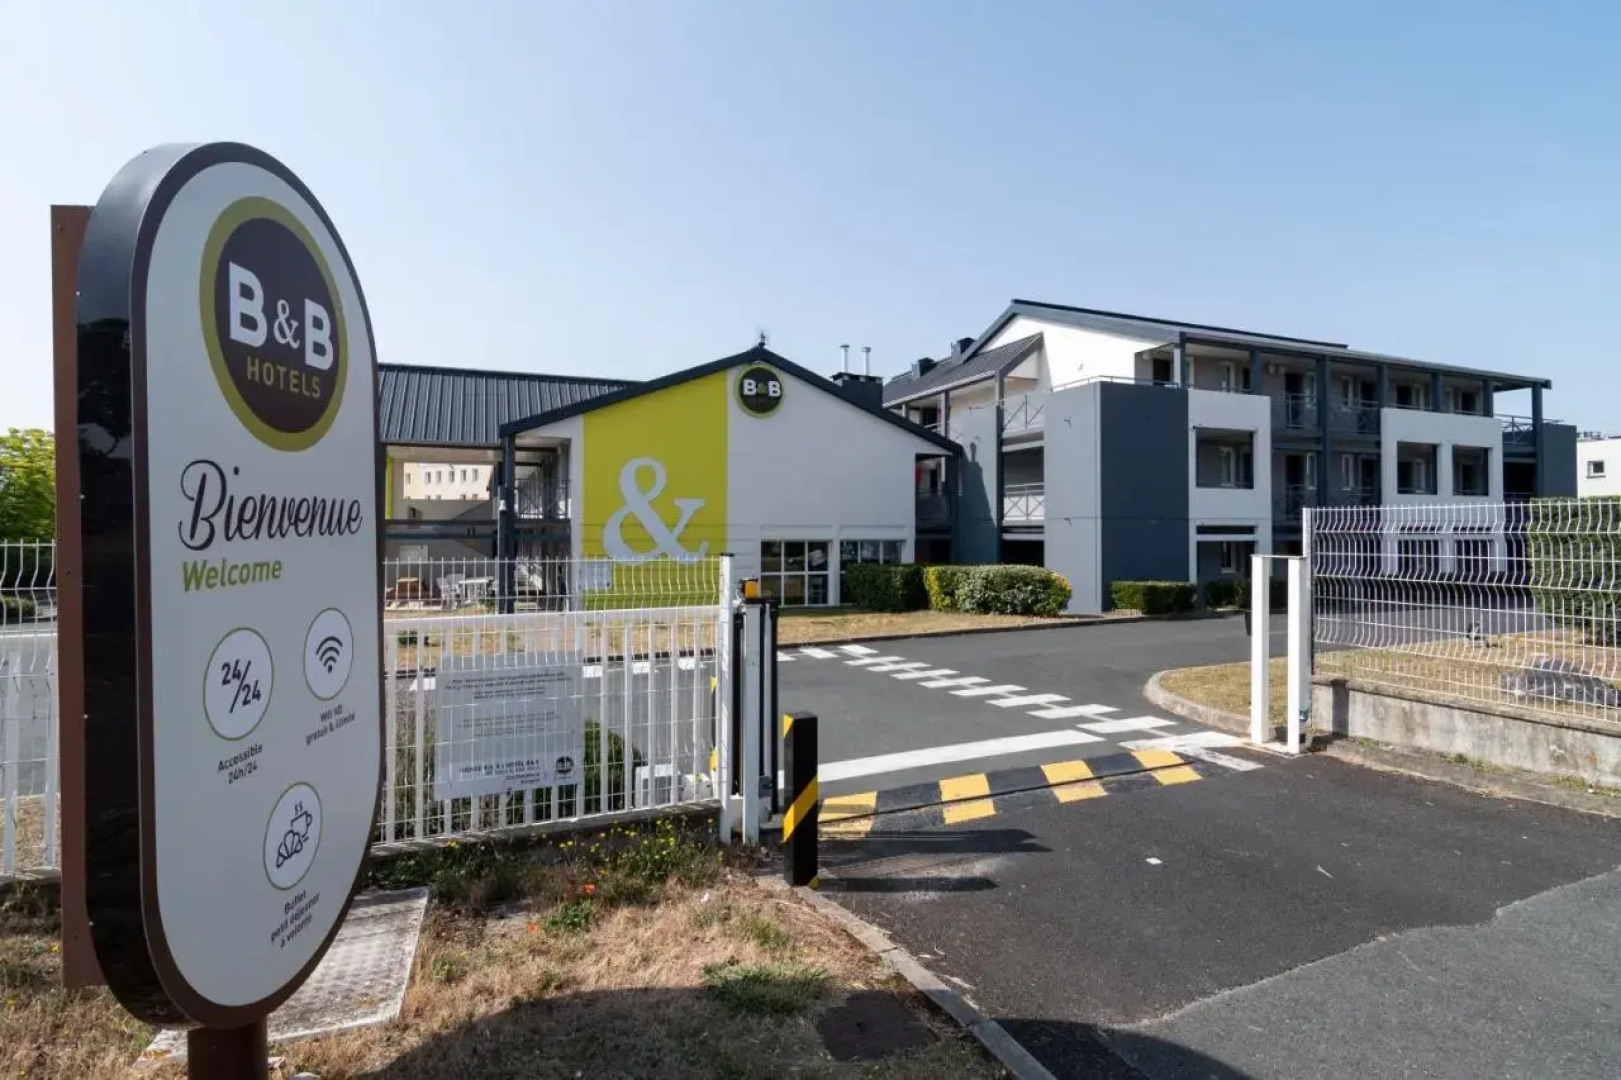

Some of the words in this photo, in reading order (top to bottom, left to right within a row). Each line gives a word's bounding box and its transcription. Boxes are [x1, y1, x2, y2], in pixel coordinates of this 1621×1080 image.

[229, 261, 334, 370] B&B
[247, 356, 321, 398] HOTELS
[179, 459, 363, 551] Bienvenue
[603, 457, 709, 566] &
[182, 558, 282, 593] Welcome
[218, 743, 263, 772] Accessible
[228, 761, 258, 785] 24h/24
